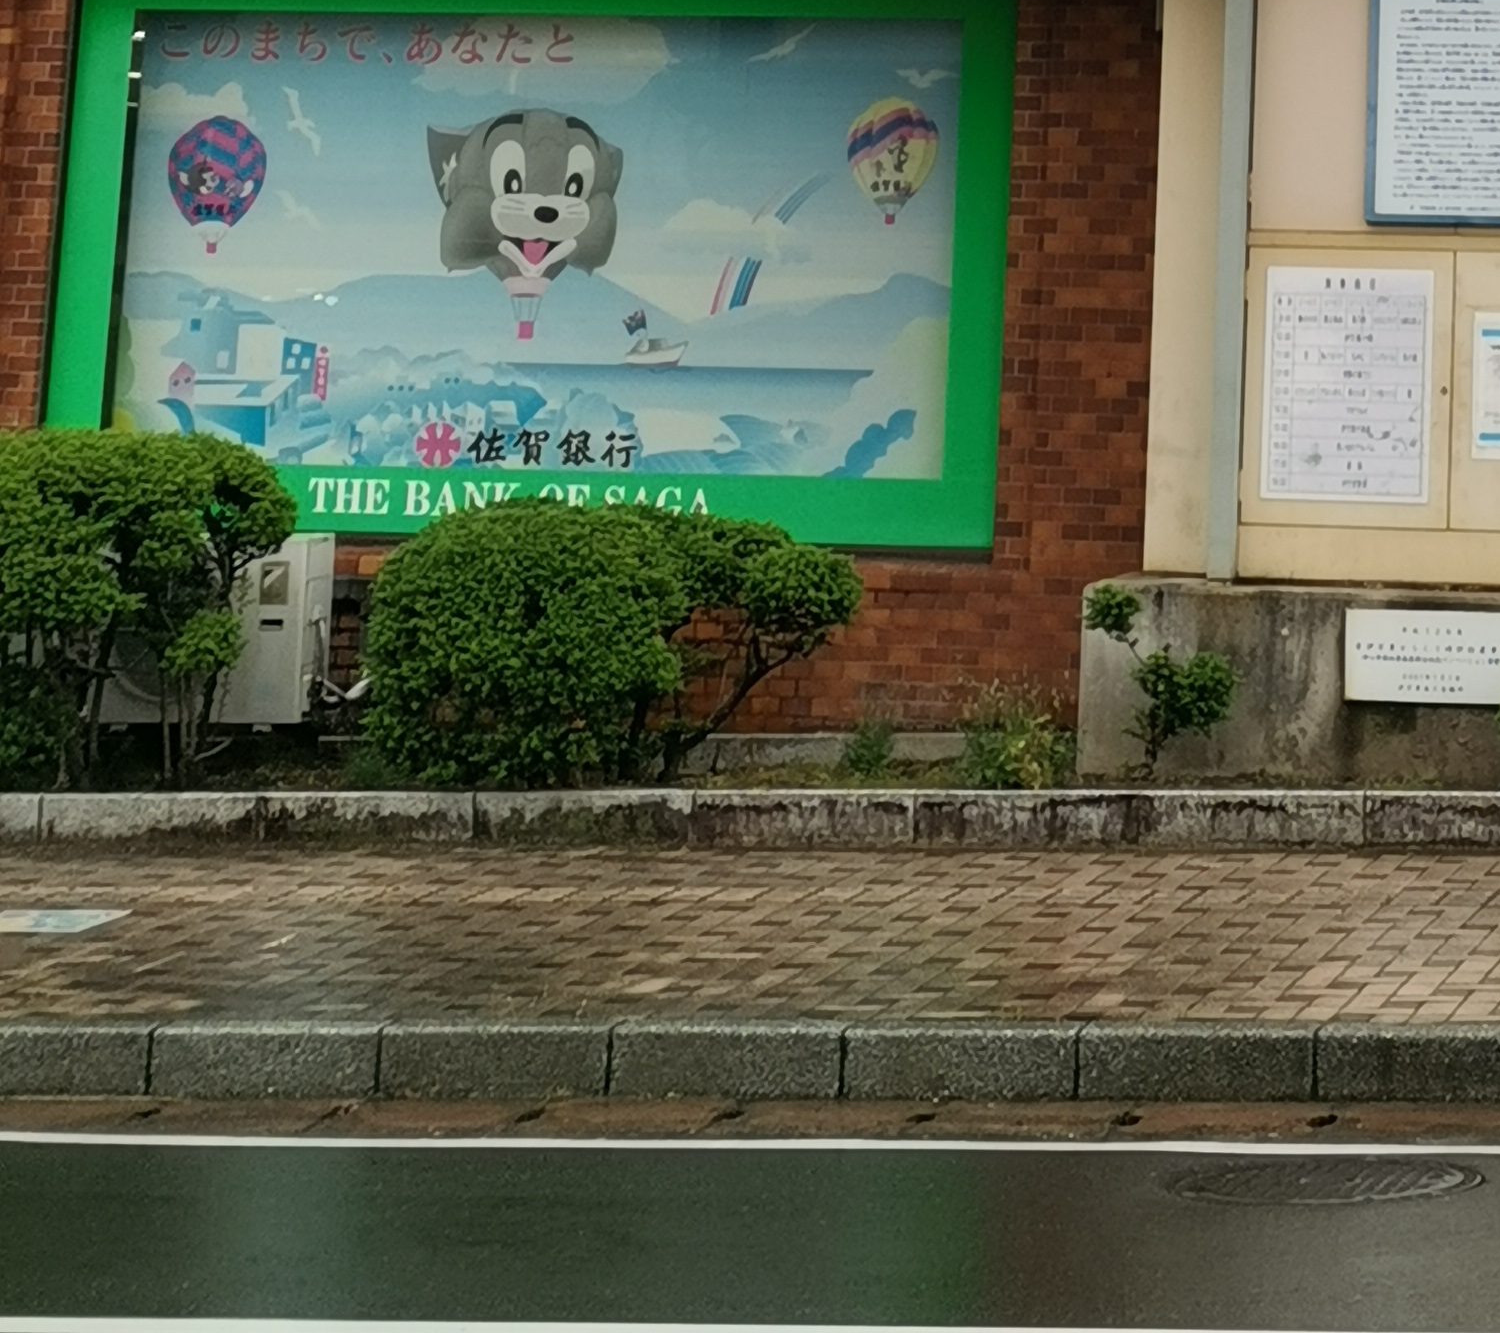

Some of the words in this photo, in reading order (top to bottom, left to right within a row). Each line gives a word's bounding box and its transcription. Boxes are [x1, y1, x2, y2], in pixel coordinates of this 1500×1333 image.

[160, 22, 575, 65] このまちで、あなたと
[467, 429, 639, 469] 佐賀銀行
[308, 477, 391, 515] THE
